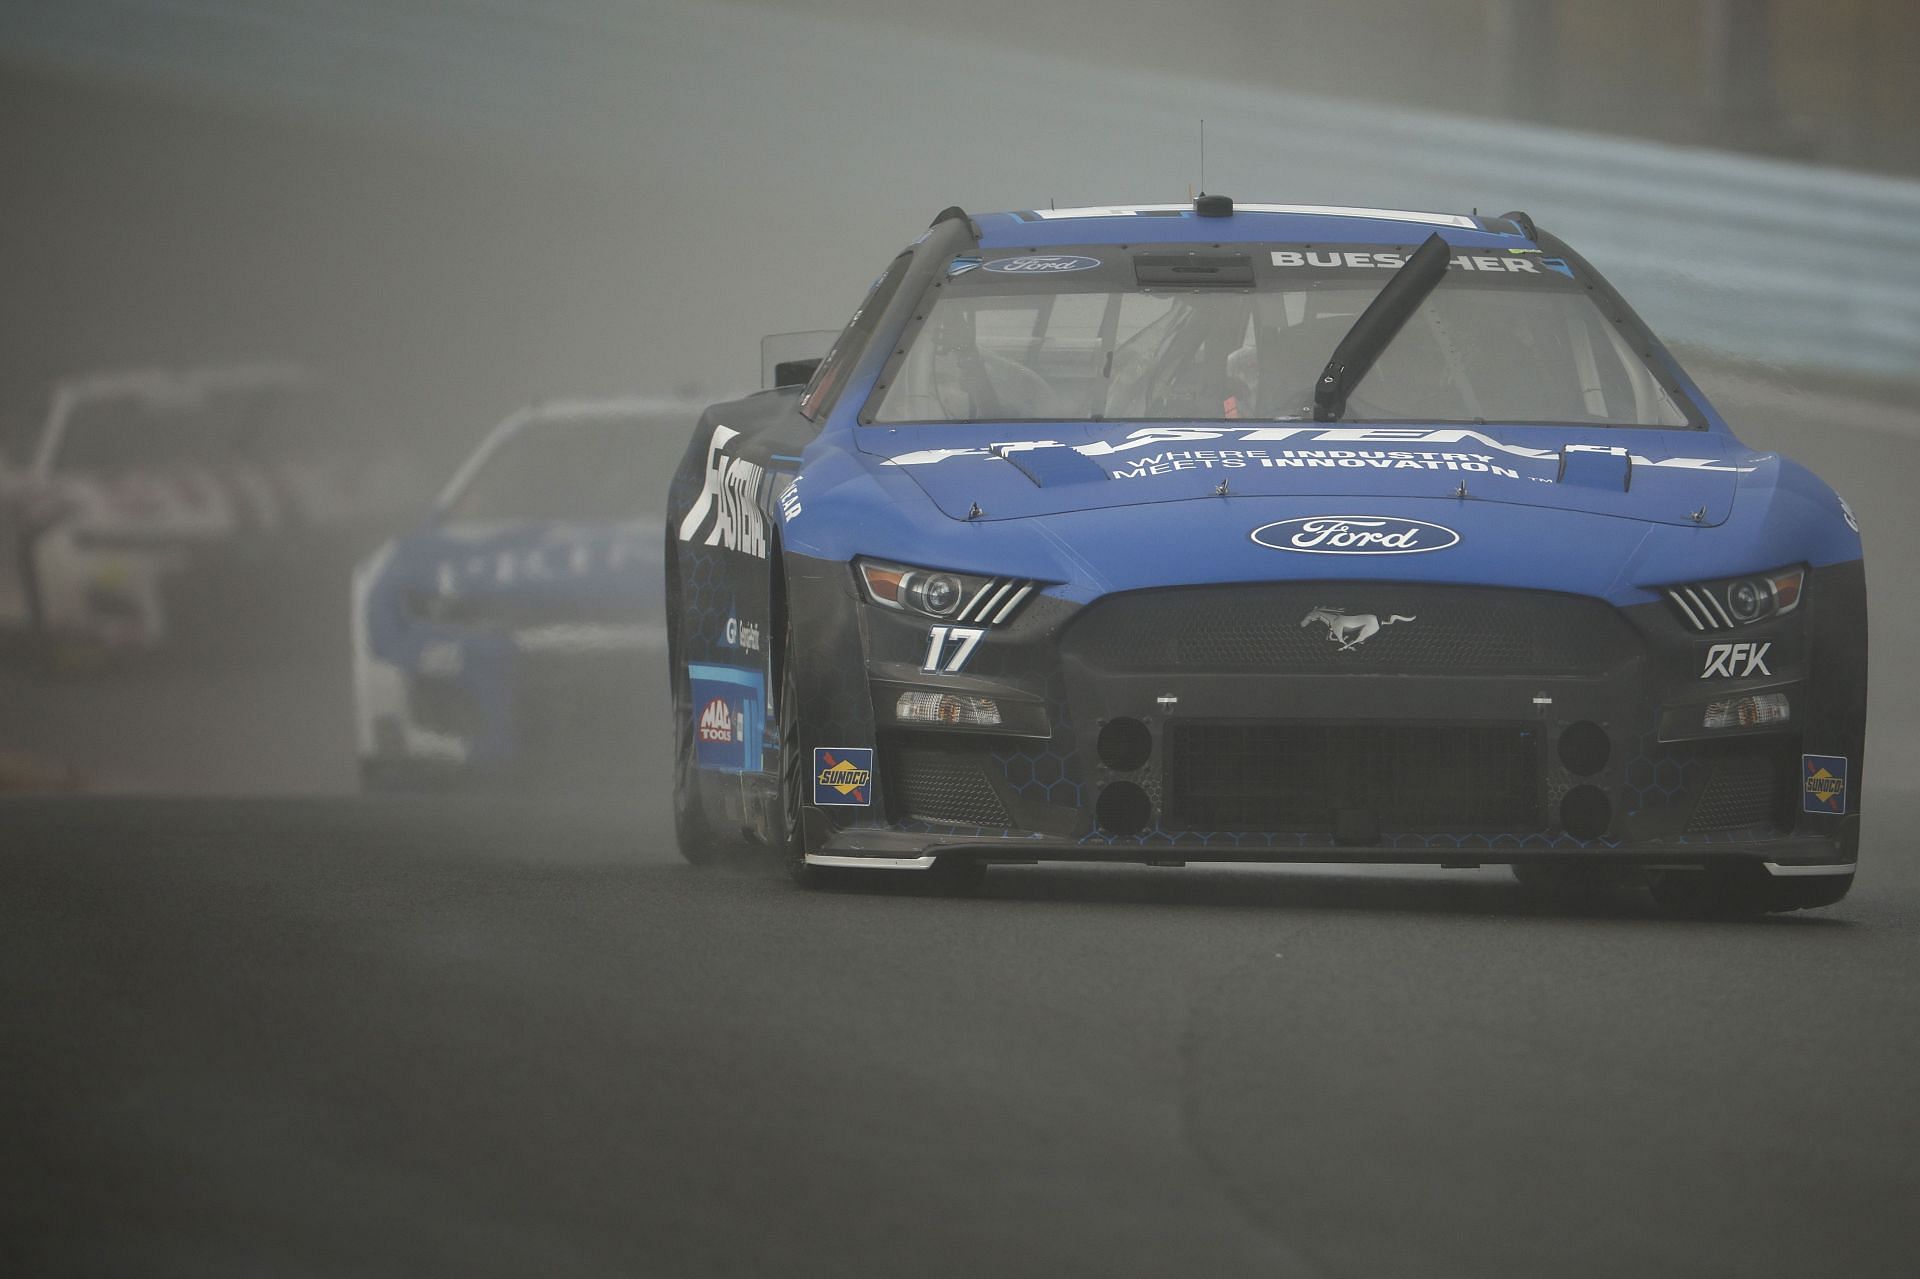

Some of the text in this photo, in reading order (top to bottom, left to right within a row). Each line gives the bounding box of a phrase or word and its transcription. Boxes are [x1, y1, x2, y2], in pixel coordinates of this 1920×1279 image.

[1003, 256, 1078, 271] Ford
[1271, 251, 1541, 274] BUESHER
[1112, 458, 1246, 479] MEETS
[1260, 458, 1520, 479] INNOVATION
[1127, 450, 1494, 468] WHERE INDUSTRY
[1291, 519, 1420, 548] Ford
[921, 626, 988, 675] 17
[1700, 642, 1772, 679] RFK
[700, 728, 732, 742] TOOLS
[822, 771, 869, 784] SUNOCO
[1807, 777, 1842, 792] SUNOCO
